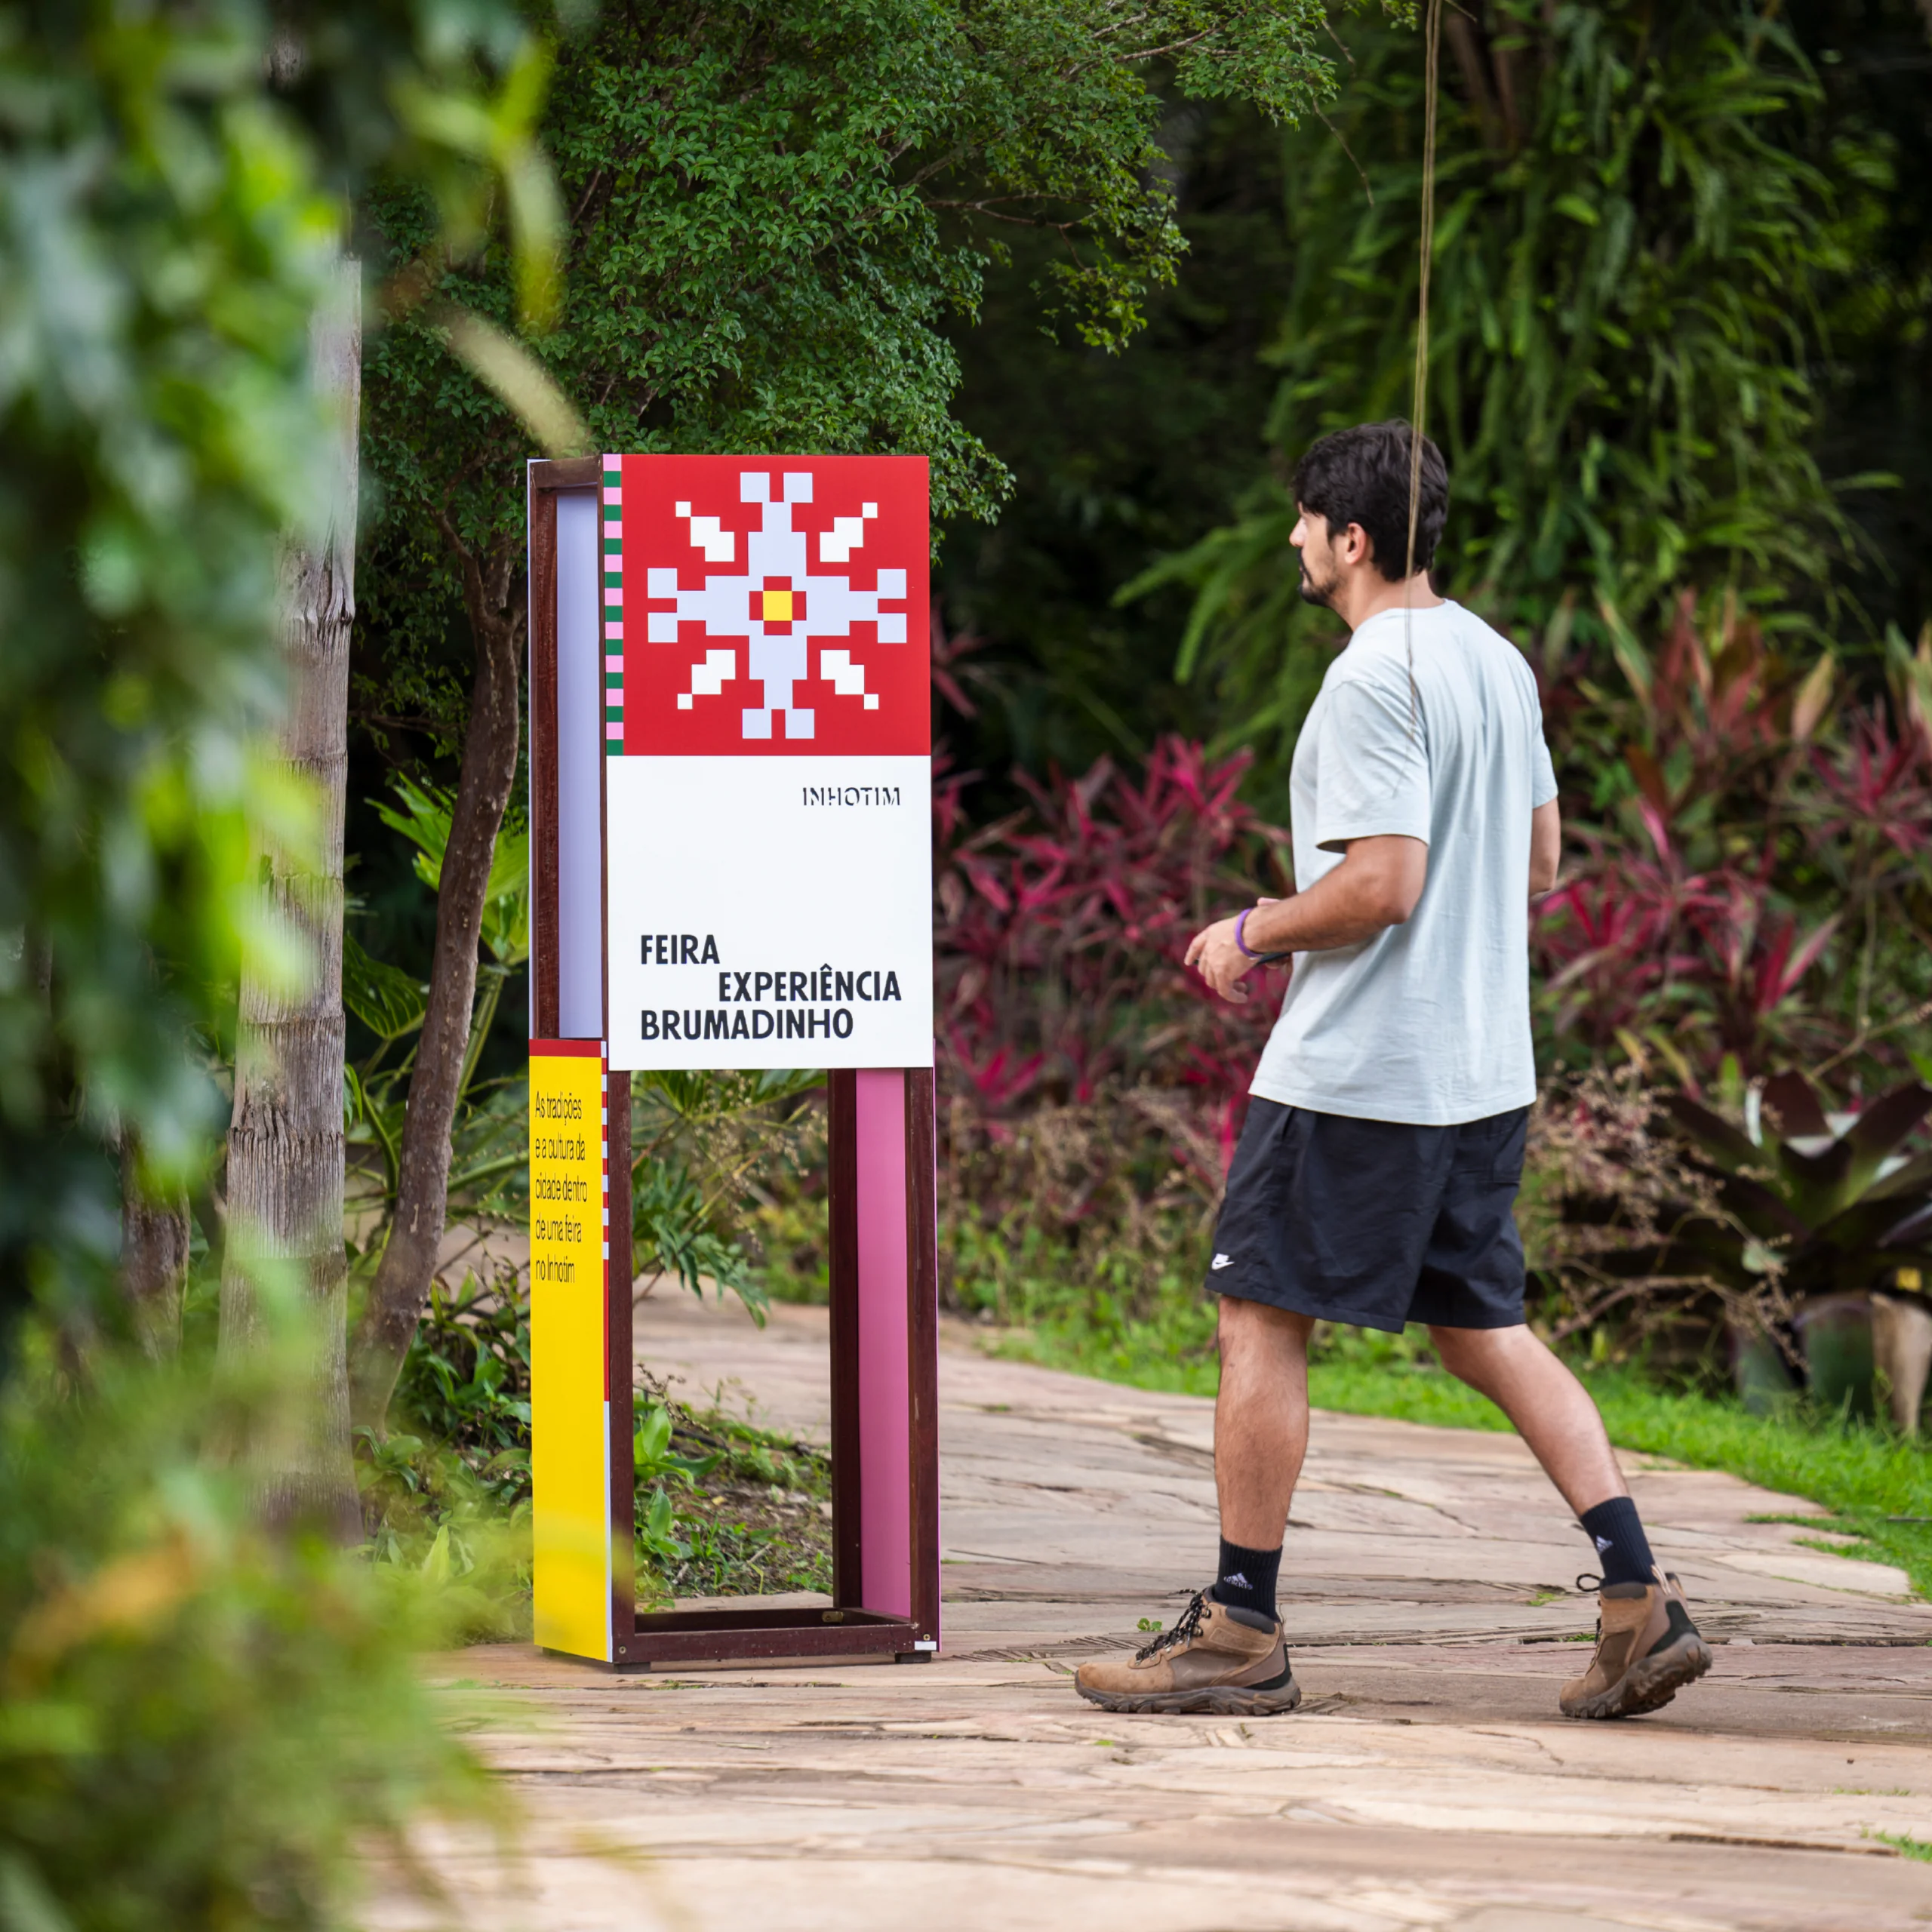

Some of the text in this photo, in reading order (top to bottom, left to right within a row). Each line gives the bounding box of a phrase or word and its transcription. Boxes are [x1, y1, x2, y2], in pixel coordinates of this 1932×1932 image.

[802, 786, 900, 806] INHOTIM
[641, 934, 721, 964] FEIRA
[718, 963, 902, 1001] EXPERIÊNCIA
[641, 1008, 854, 1041] BRUMADINHO
[535, 1091, 582, 1125] As tradições
[535, 1131, 585, 1161] e a cultura da
[535, 1172, 587, 1202] cidade dentro
[536, 1212, 582, 1243] de uma feira
[536, 1254, 575, 1283] no Inhotim
